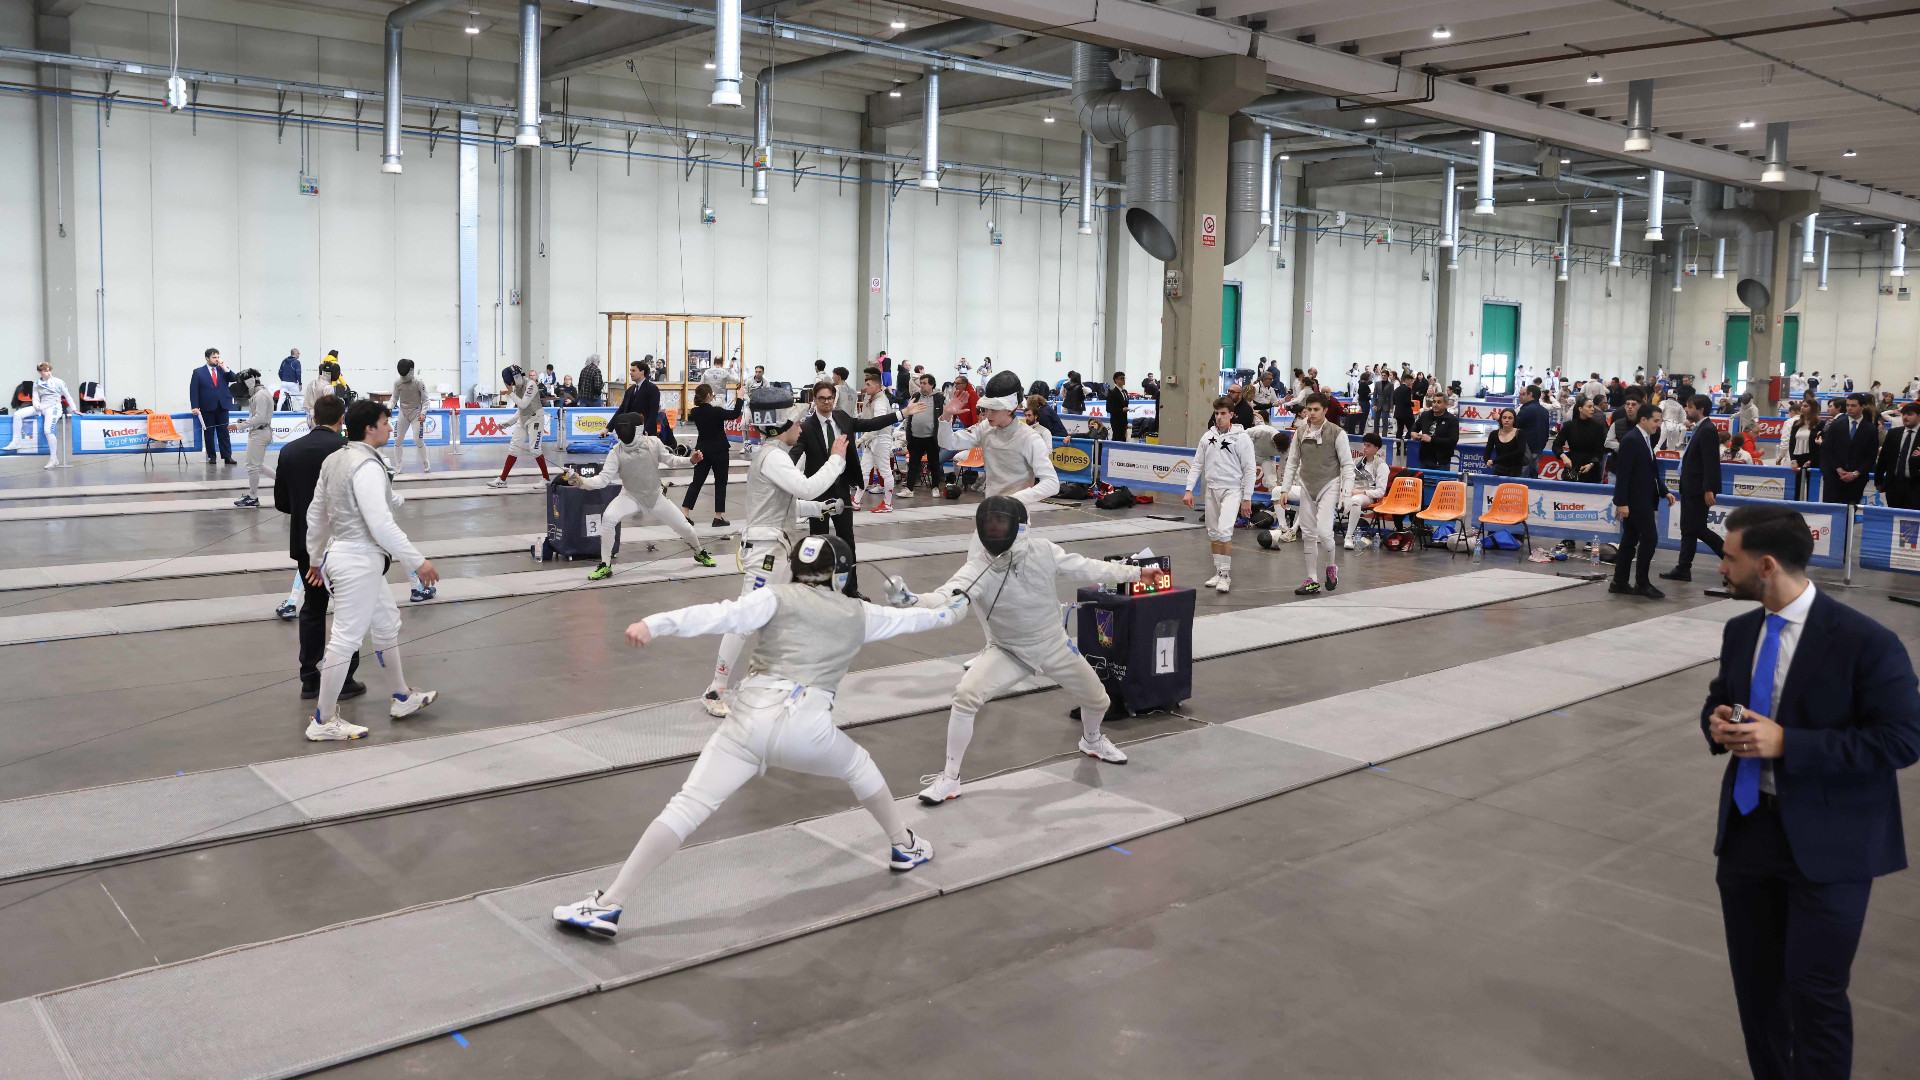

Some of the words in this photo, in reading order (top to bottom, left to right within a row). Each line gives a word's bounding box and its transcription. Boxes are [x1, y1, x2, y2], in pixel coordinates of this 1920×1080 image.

[577, 419, 607, 429] Telpress
[103, 427, 139, 438] Kinder
[107, 439, 119, 447] Joy
[120, 438, 128, 446] of
[129, 437, 148, 445] movin
[533, 431, 542, 450] ITALIA
[1052, 451, 1088, 465] Telpress
[581, 467, 595, 475] 0:44
[1553, 501, 1586, 512] Kinder
[1556, 513, 1567, 521] Joy
[1576, 513, 1597, 521] moving
[589, 521, 597, 533] 3
[1160, 648, 1168, 668] 1
